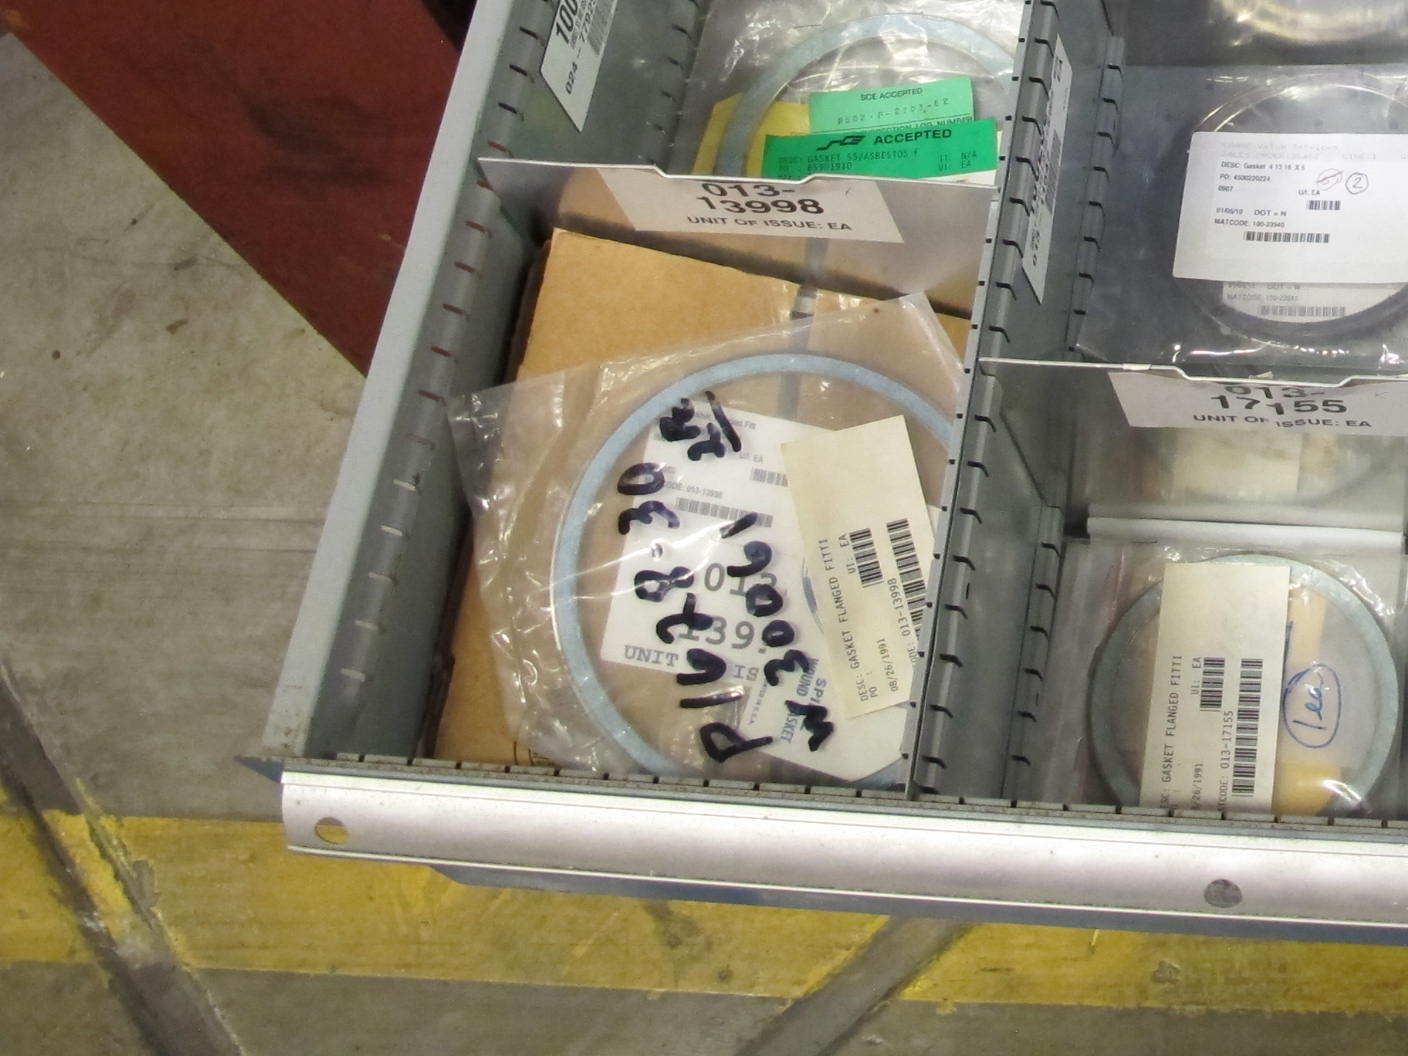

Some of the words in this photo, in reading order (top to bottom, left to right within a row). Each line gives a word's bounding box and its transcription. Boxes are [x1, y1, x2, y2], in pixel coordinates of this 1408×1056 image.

[879, 87, 923, 99] ACCEPTED
[874, 129, 952, 145] ACCEPTED
[702, 183, 796, 197] 013-
[697, 196, 824, 214] 13998
[688, 216, 728, 224] UNIT
[734, 218, 758, 226] OF
[828, 222, 852, 230] EA
[1225, 385, 1325, 399] 013-
[1211, 395, 1347, 415] 17155
[1193, 414, 1238, 423] UNIT
[1244, 416, 1269, 424] OF
[1346, 420, 1371, 428] EA
[838, 533, 849, 548] EA
[818, 538, 835, 571] FITTI
[828, 576, 848, 623] FLANGED
[887, 578, 911, 637] 013-13998
[624, 645, 679, 668] UNIT
[842, 630, 860, 670] GASKET
[1170, 655, 1182, 686] FITTI
[1192, 656, 1201, 669] EA
[1165, 692, 1179, 737] FLANGED
[1219, 710, 1234, 769] 013-17155
[1161, 744, 1174, 783] GASKET
